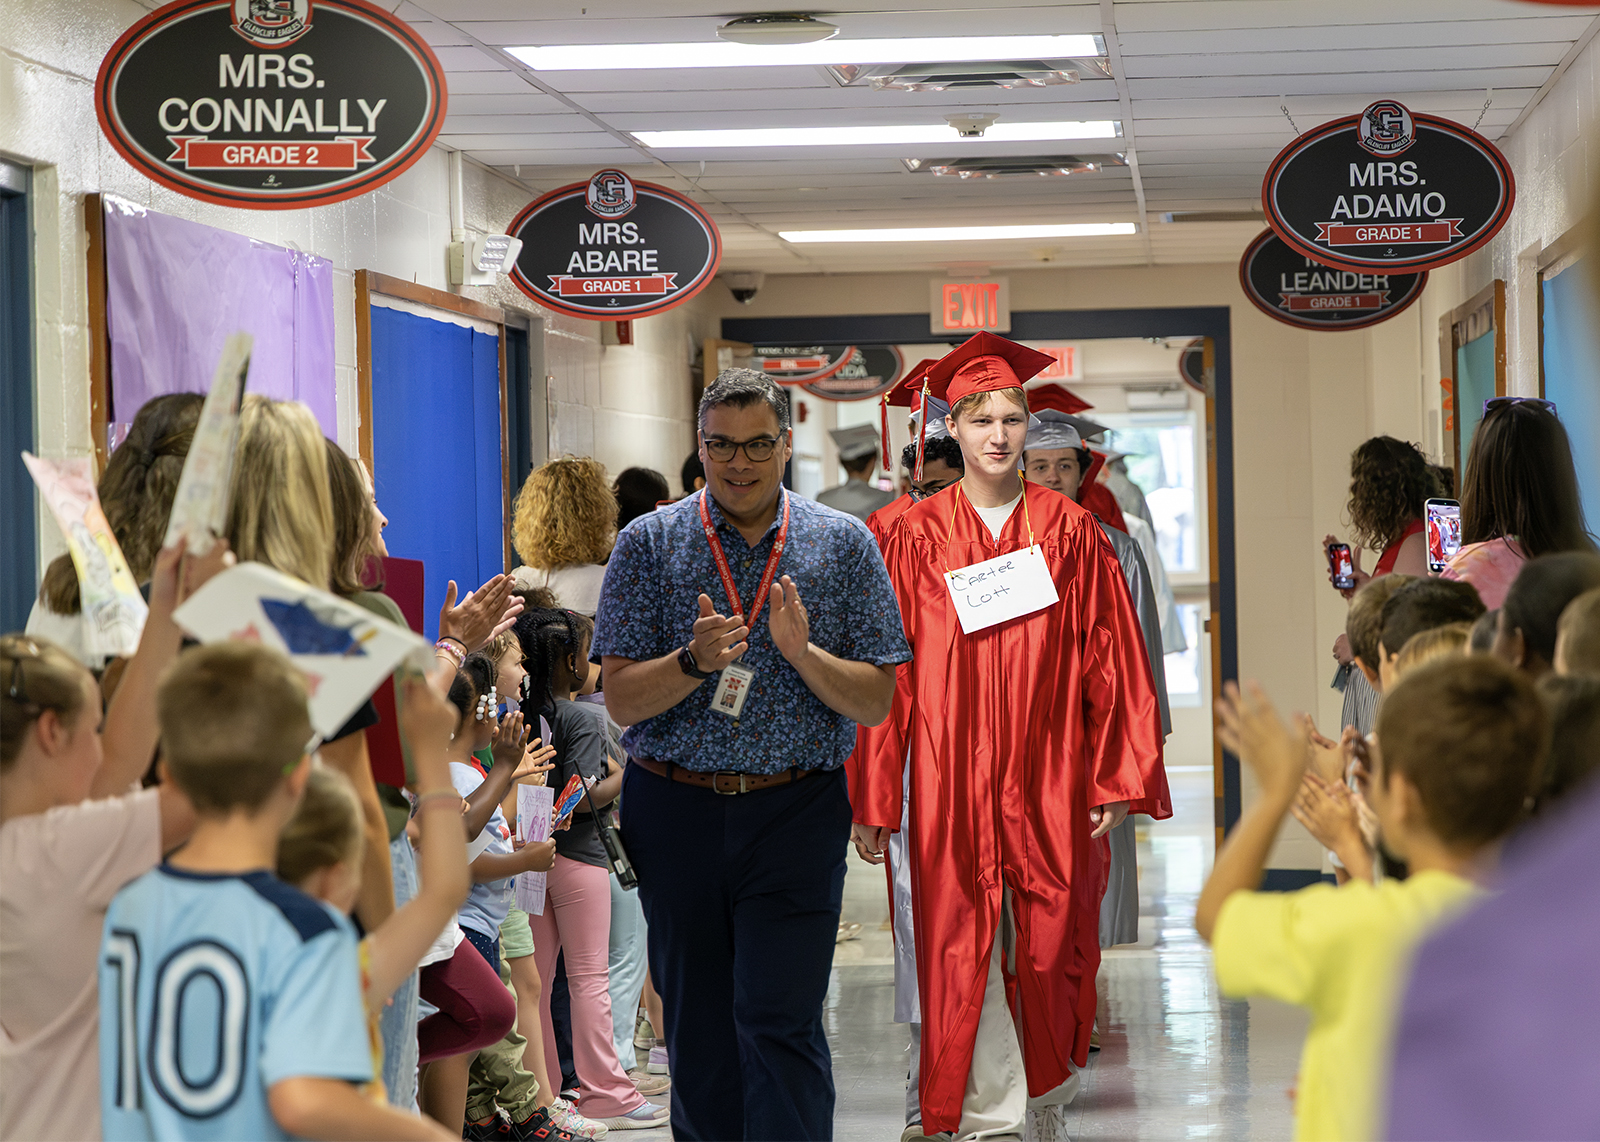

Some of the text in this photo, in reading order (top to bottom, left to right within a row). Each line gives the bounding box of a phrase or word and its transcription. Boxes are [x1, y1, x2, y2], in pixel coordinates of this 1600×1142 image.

[243, 21, 301, 38] GLENCLIFF EAGLES
[219, 53, 325, 88] MRS.
[158, 97, 387, 133] CONNALLY
[222, 146, 319, 165] GRADE 2
[1366, 137, 1408, 150] GLENCLIFF EAGLES
[1349, 161, 1426, 187] MRS.
[1330, 192, 1446, 219] ADAMO
[578, 221, 646, 245] MRS.
[1355, 227, 1423, 241] GRADE 1
[566, 249, 659, 274] ABARE
[582, 280, 641, 293] GRADE 1
[1281, 271, 1389, 292] LEANDER
[942, 283, 1000, 329] EXIT
[1310, 296, 1361, 308] GRADE 1
[106, 928, 250, 1121] 10
